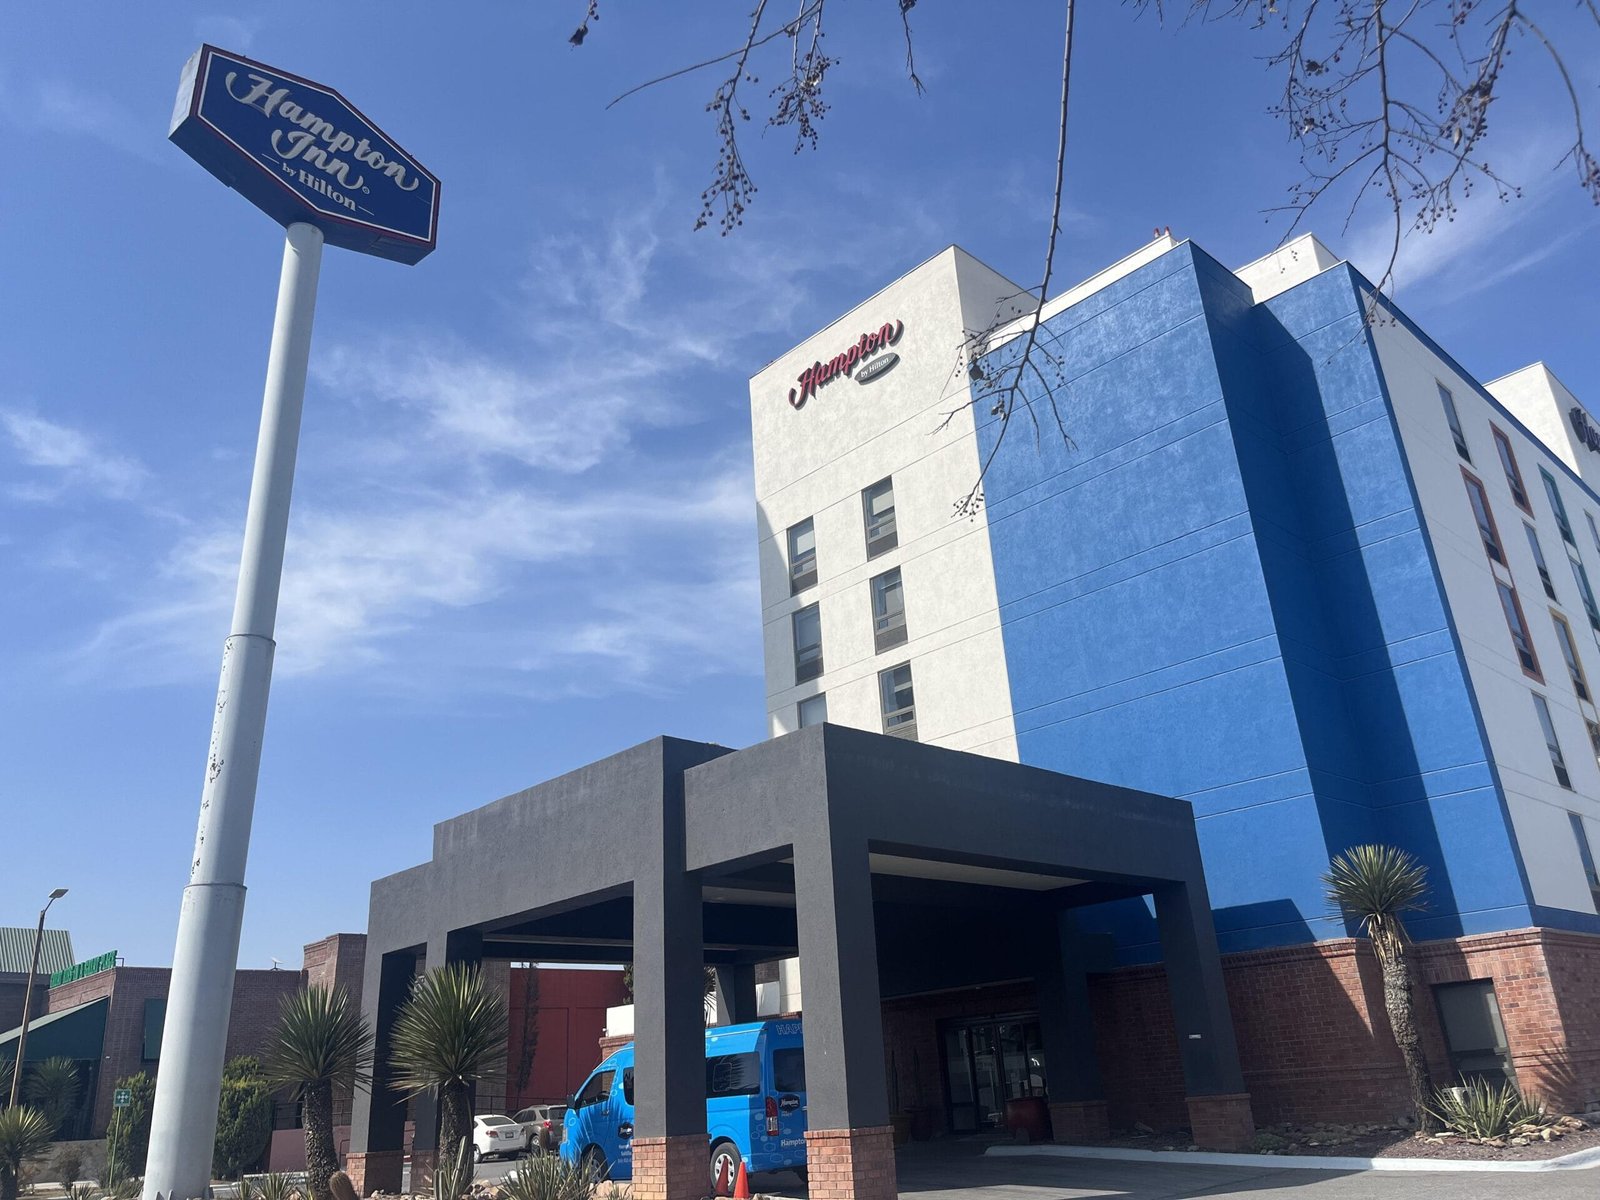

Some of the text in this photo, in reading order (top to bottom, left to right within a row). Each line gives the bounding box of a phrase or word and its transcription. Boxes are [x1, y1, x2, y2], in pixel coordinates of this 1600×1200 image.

[225, 71, 419, 191] Hampton
[282, 162, 356, 212] by Hilton
[788, 319, 904, 410] Hampton
[860, 357, 889, 378] by Hilton
[780, 1138, 806, 1147] Hampto
